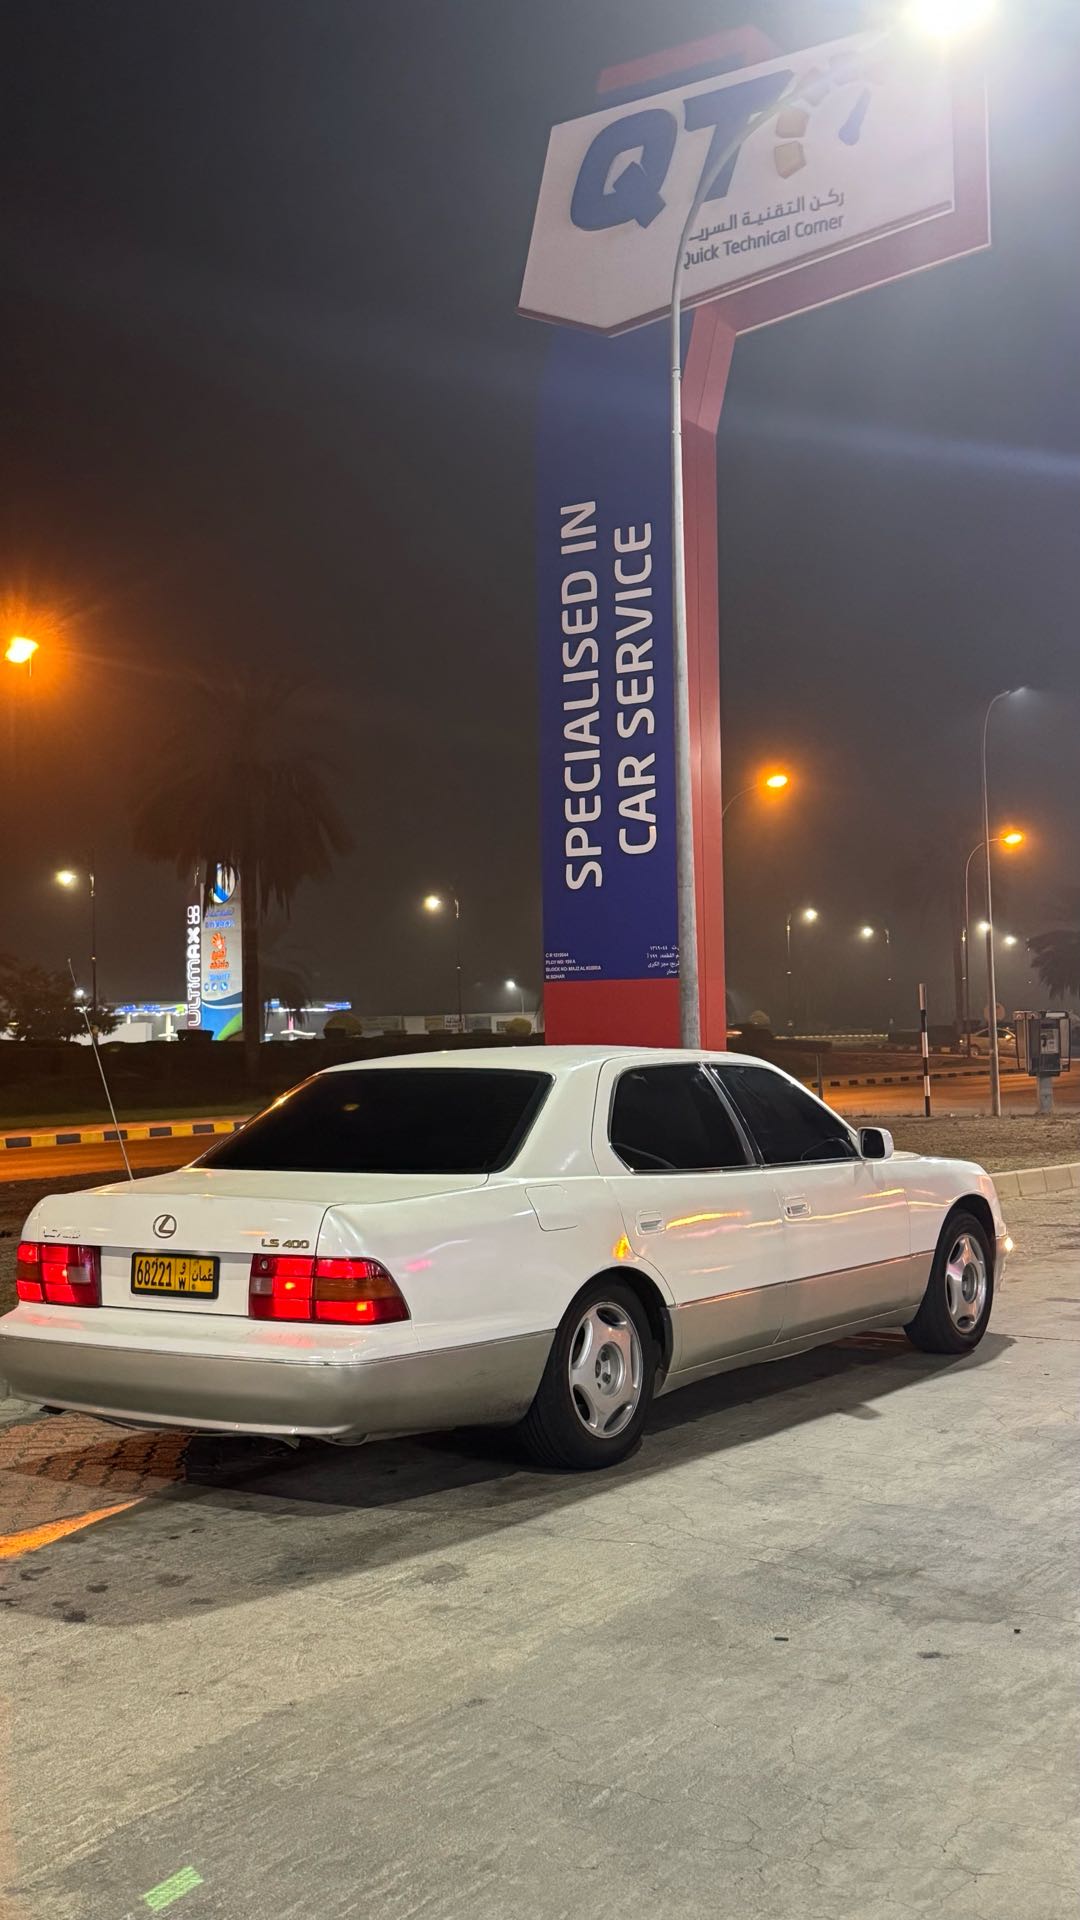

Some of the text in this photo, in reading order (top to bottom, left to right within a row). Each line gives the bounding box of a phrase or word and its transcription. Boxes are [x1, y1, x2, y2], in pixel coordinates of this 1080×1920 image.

[687, 188, 845, 241] ركن التقنية السري
[723, 225, 791, 256] Technical
[795, 215, 844, 238] Corner
[560, 500, 603, 890] SPECIALISED IN
[614, 522, 657, 855] CAR SERVICE
[187, 905, 201, 925] 98
[261, 1238, 310, 1249] LS 400
[136, 1260, 172, 1287] 68221
[178, 1277, 186, 1289] W
